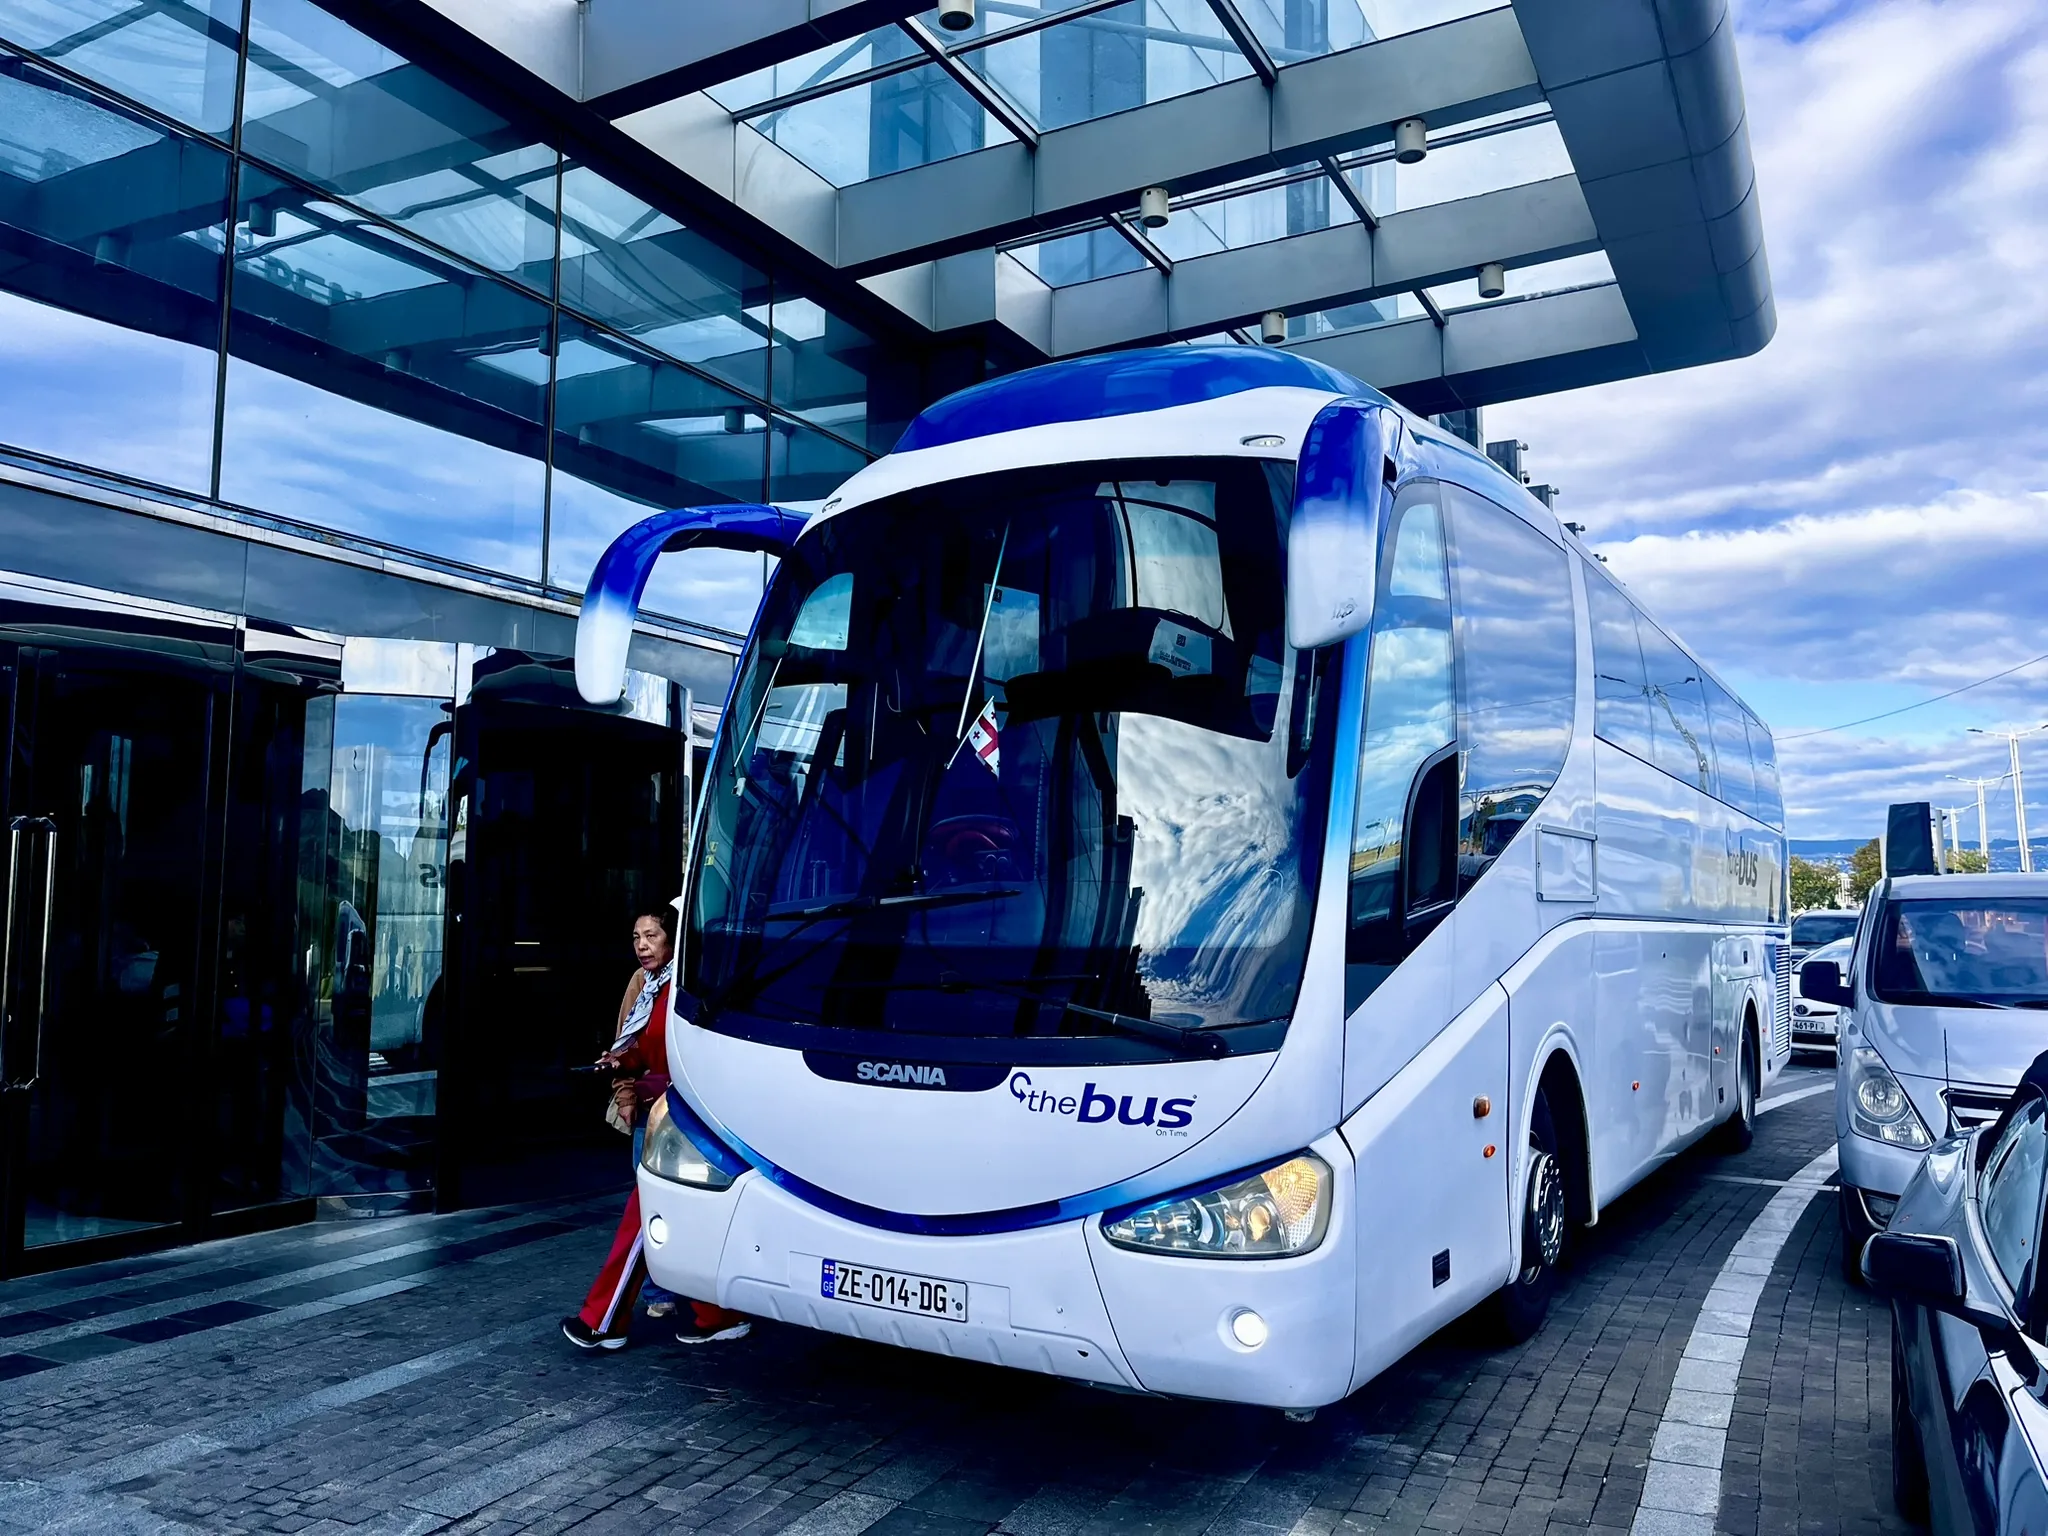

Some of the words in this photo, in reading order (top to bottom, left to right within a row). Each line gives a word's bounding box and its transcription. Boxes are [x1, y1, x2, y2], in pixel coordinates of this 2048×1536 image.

[857, 1061, 946, 1086] SCANIA
[1155, 1128, 1167, 1137] On
[1169, 1129, 1188, 1138] Time
[822, 1280, 834, 1293] GE
[837, 1266, 947, 1314] ZE-014-DG
